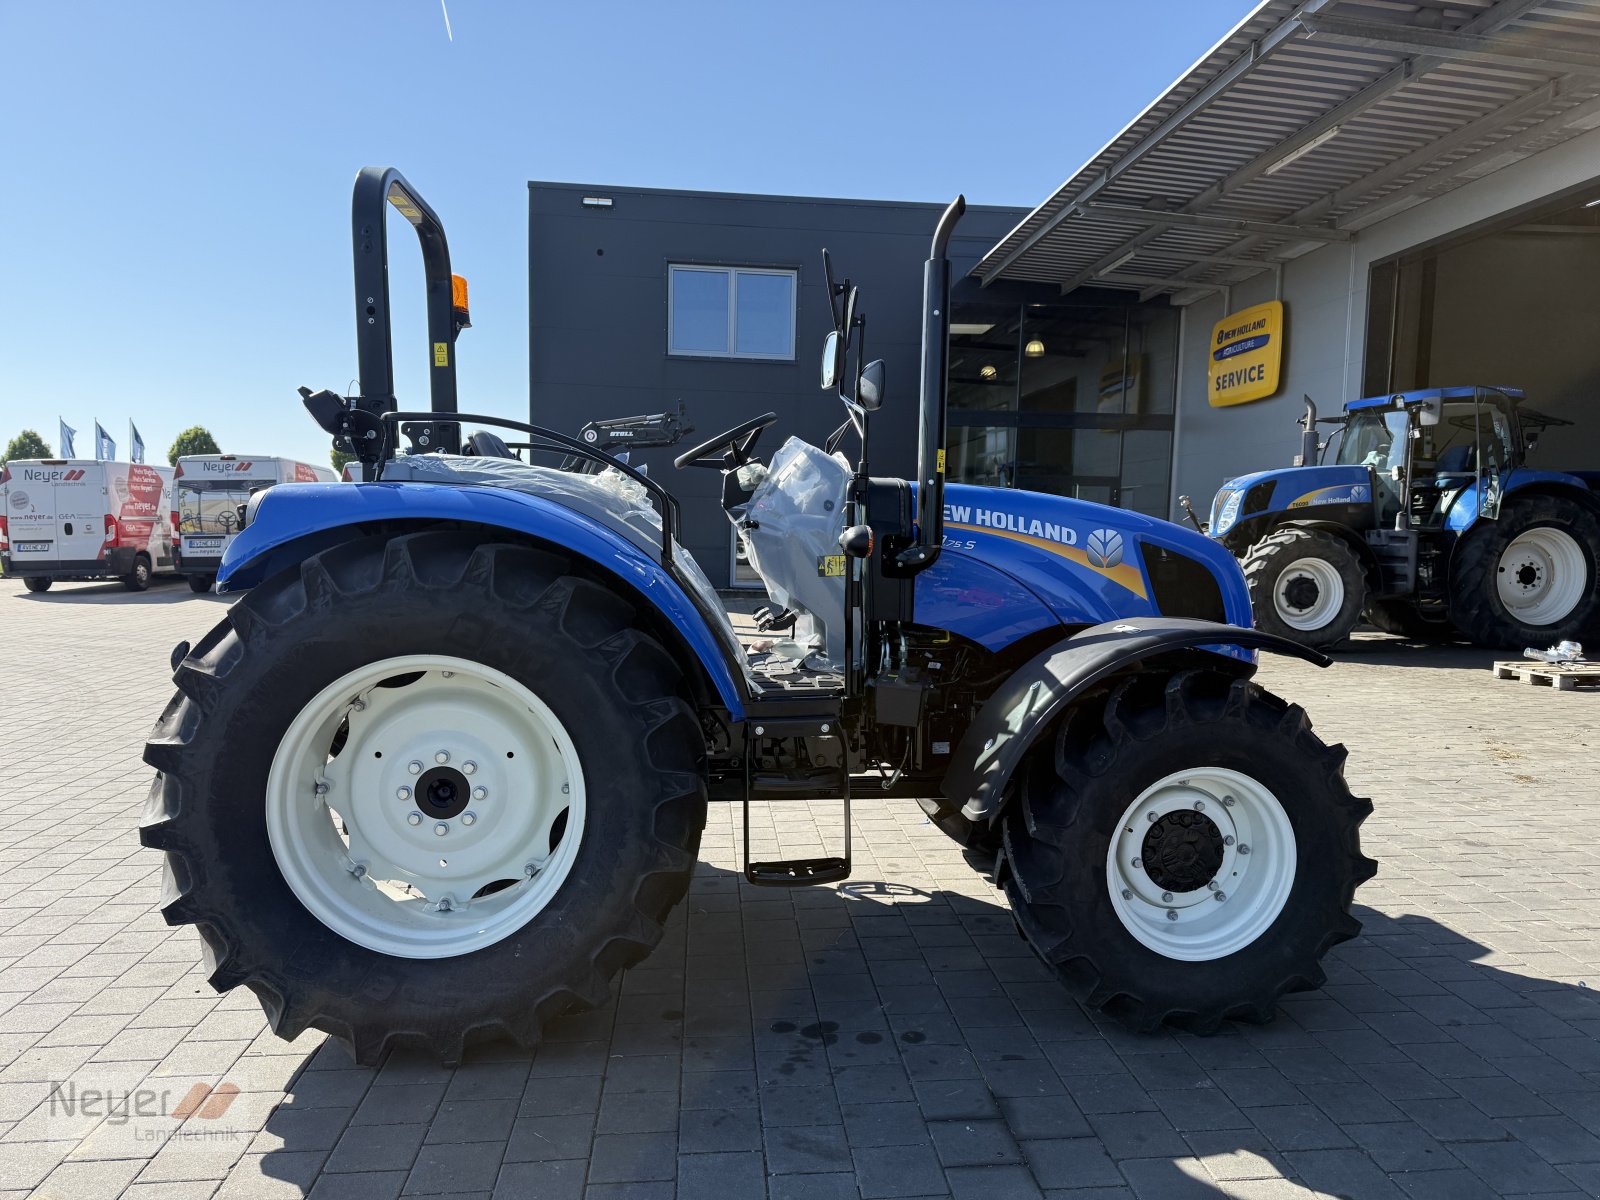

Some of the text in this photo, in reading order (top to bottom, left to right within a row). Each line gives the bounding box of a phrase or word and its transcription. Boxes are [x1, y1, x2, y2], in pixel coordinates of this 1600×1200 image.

[1224, 318, 1266, 341] NEW HOLLAND
[1222, 339, 1255, 357] AGRICULTURE
[1215, 363, 1265, 391] SERVICE
[203, 461, 236, 473] Neyer
[24, 468, 64, 482] Neyer
[1313, 496, 1351, 505] New Holland
[10, 514, 54, 522] www.neyer.de
[943, 504, 1078, 546] EW HOLLAND
[963, 540, 977, 550] S
